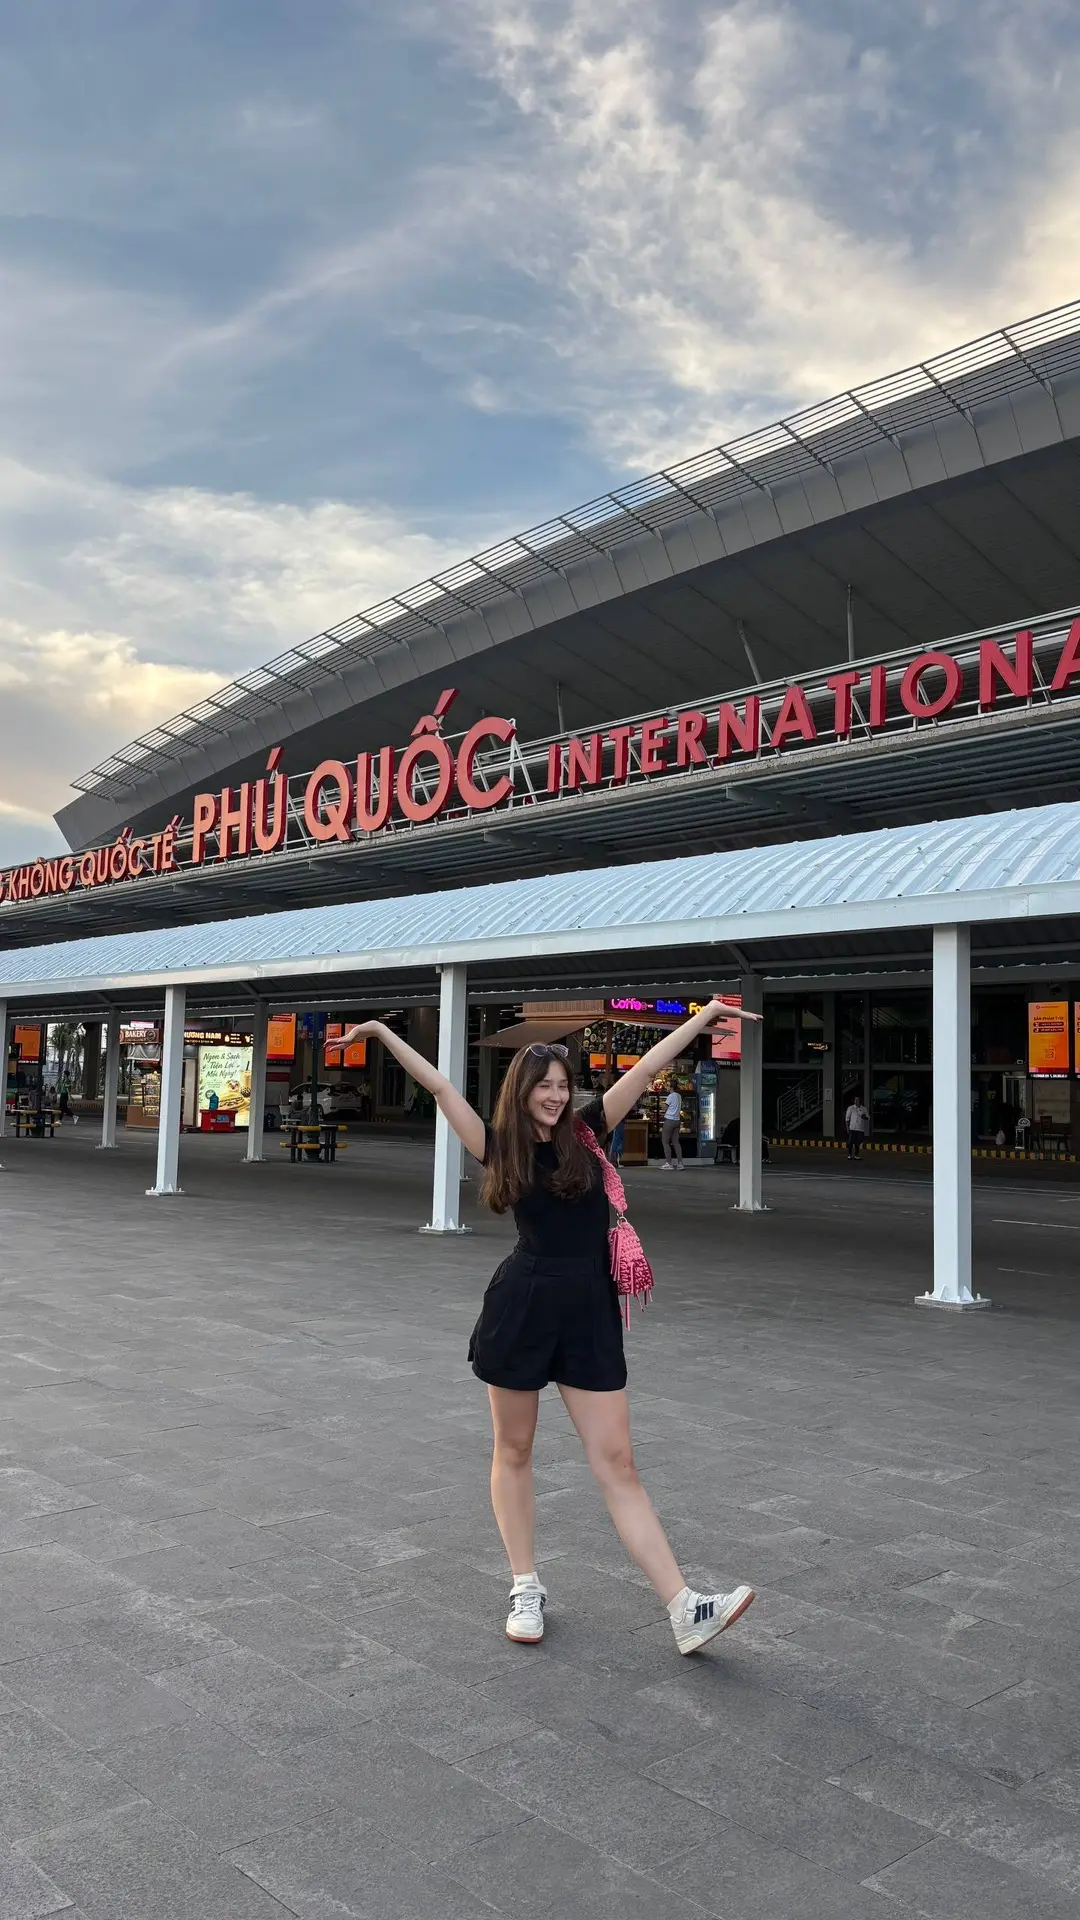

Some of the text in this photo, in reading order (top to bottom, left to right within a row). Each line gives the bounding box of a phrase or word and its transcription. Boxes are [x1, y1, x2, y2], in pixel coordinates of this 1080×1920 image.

[9, 616, 1080, 900] KHÔNG QUỐC TẾ PHÚ QUỐC INTERNATIONA
[611, 997, 647, 1011] Coffee
[125, 1030, 147, 1038] BAKERY
[205, 1032, 221, 1040] NAM
[203, 1053, 219, 1063] Ngon
[221, 1052, 226, 1060] &
